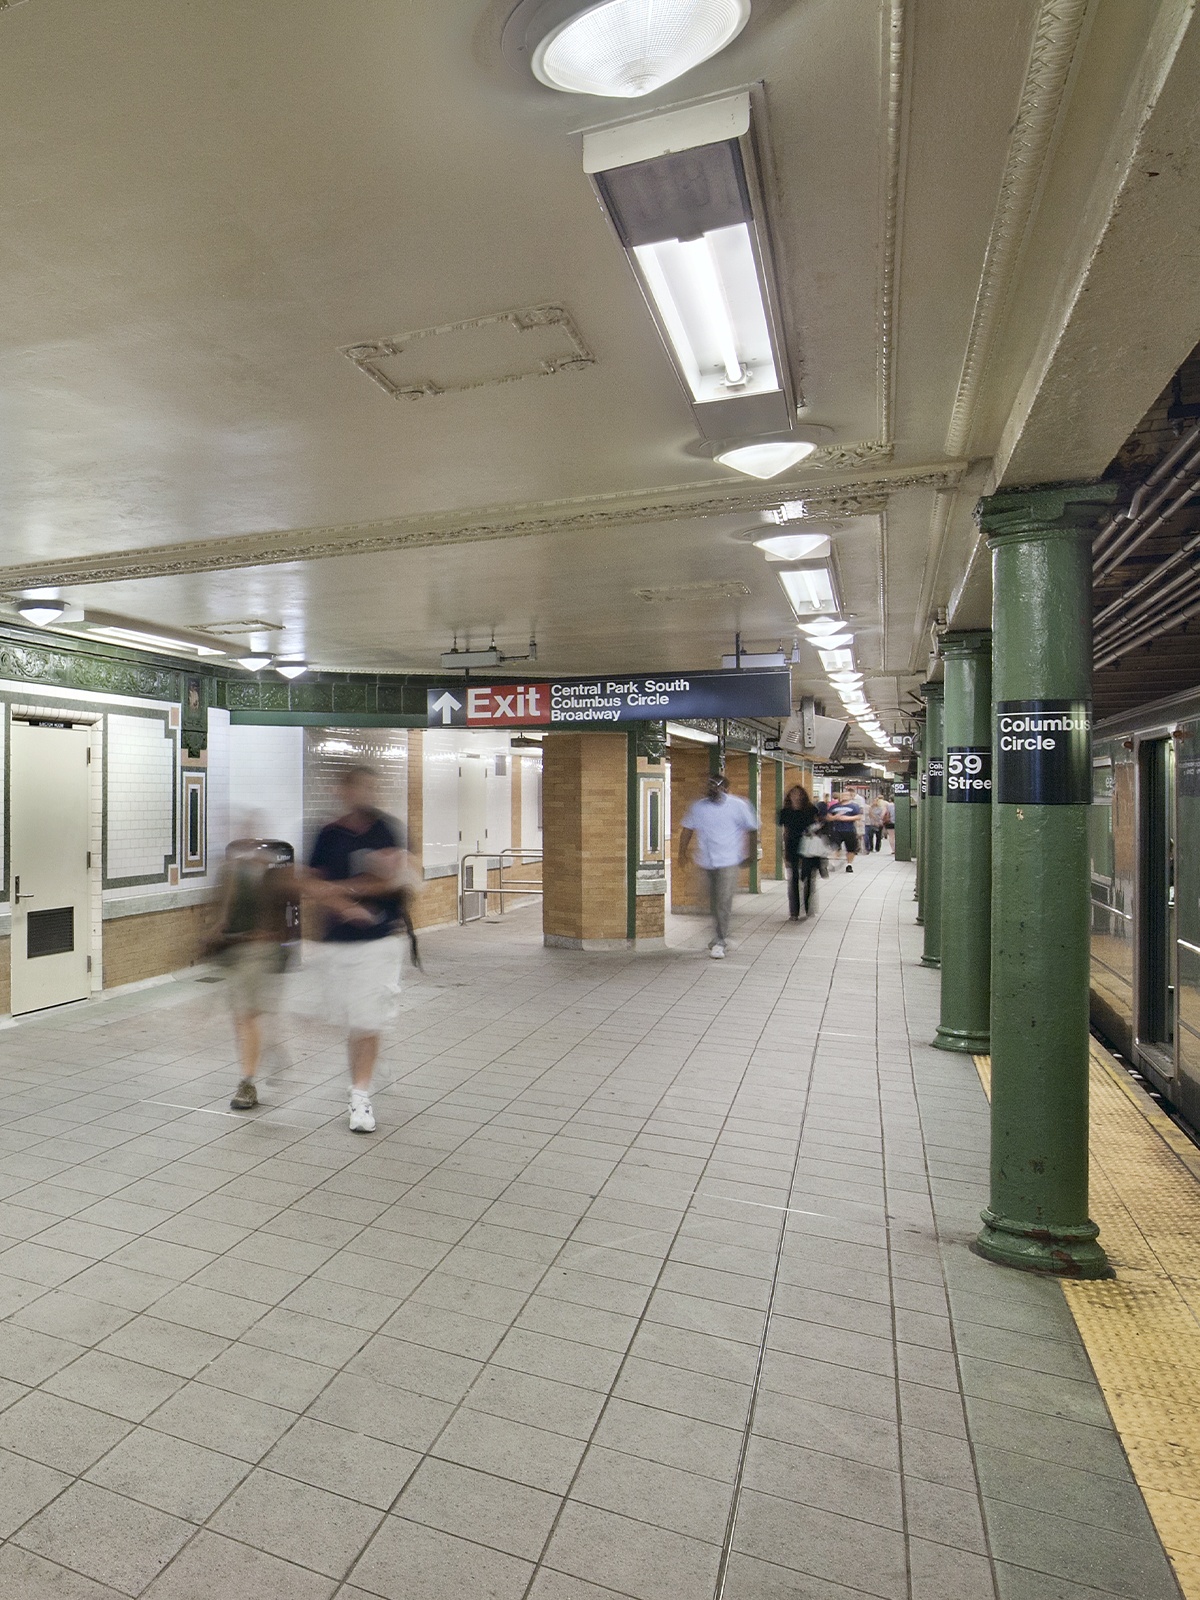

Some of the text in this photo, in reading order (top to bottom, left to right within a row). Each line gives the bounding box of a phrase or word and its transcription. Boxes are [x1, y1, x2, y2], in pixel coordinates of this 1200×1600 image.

[551, 679, 690, 697] Central Park South
[467, 686, 541, 719] Exit
[551, 693, 670, 709] Columbus Circle
[551, 709, 621, 722] Broadway
[1000, 716, 1091, 733] Columbus
[1000, 735, 1056, 751] Circle
[948, 755, 982, 775] 59
[948, 776, 991, 790] Stree
